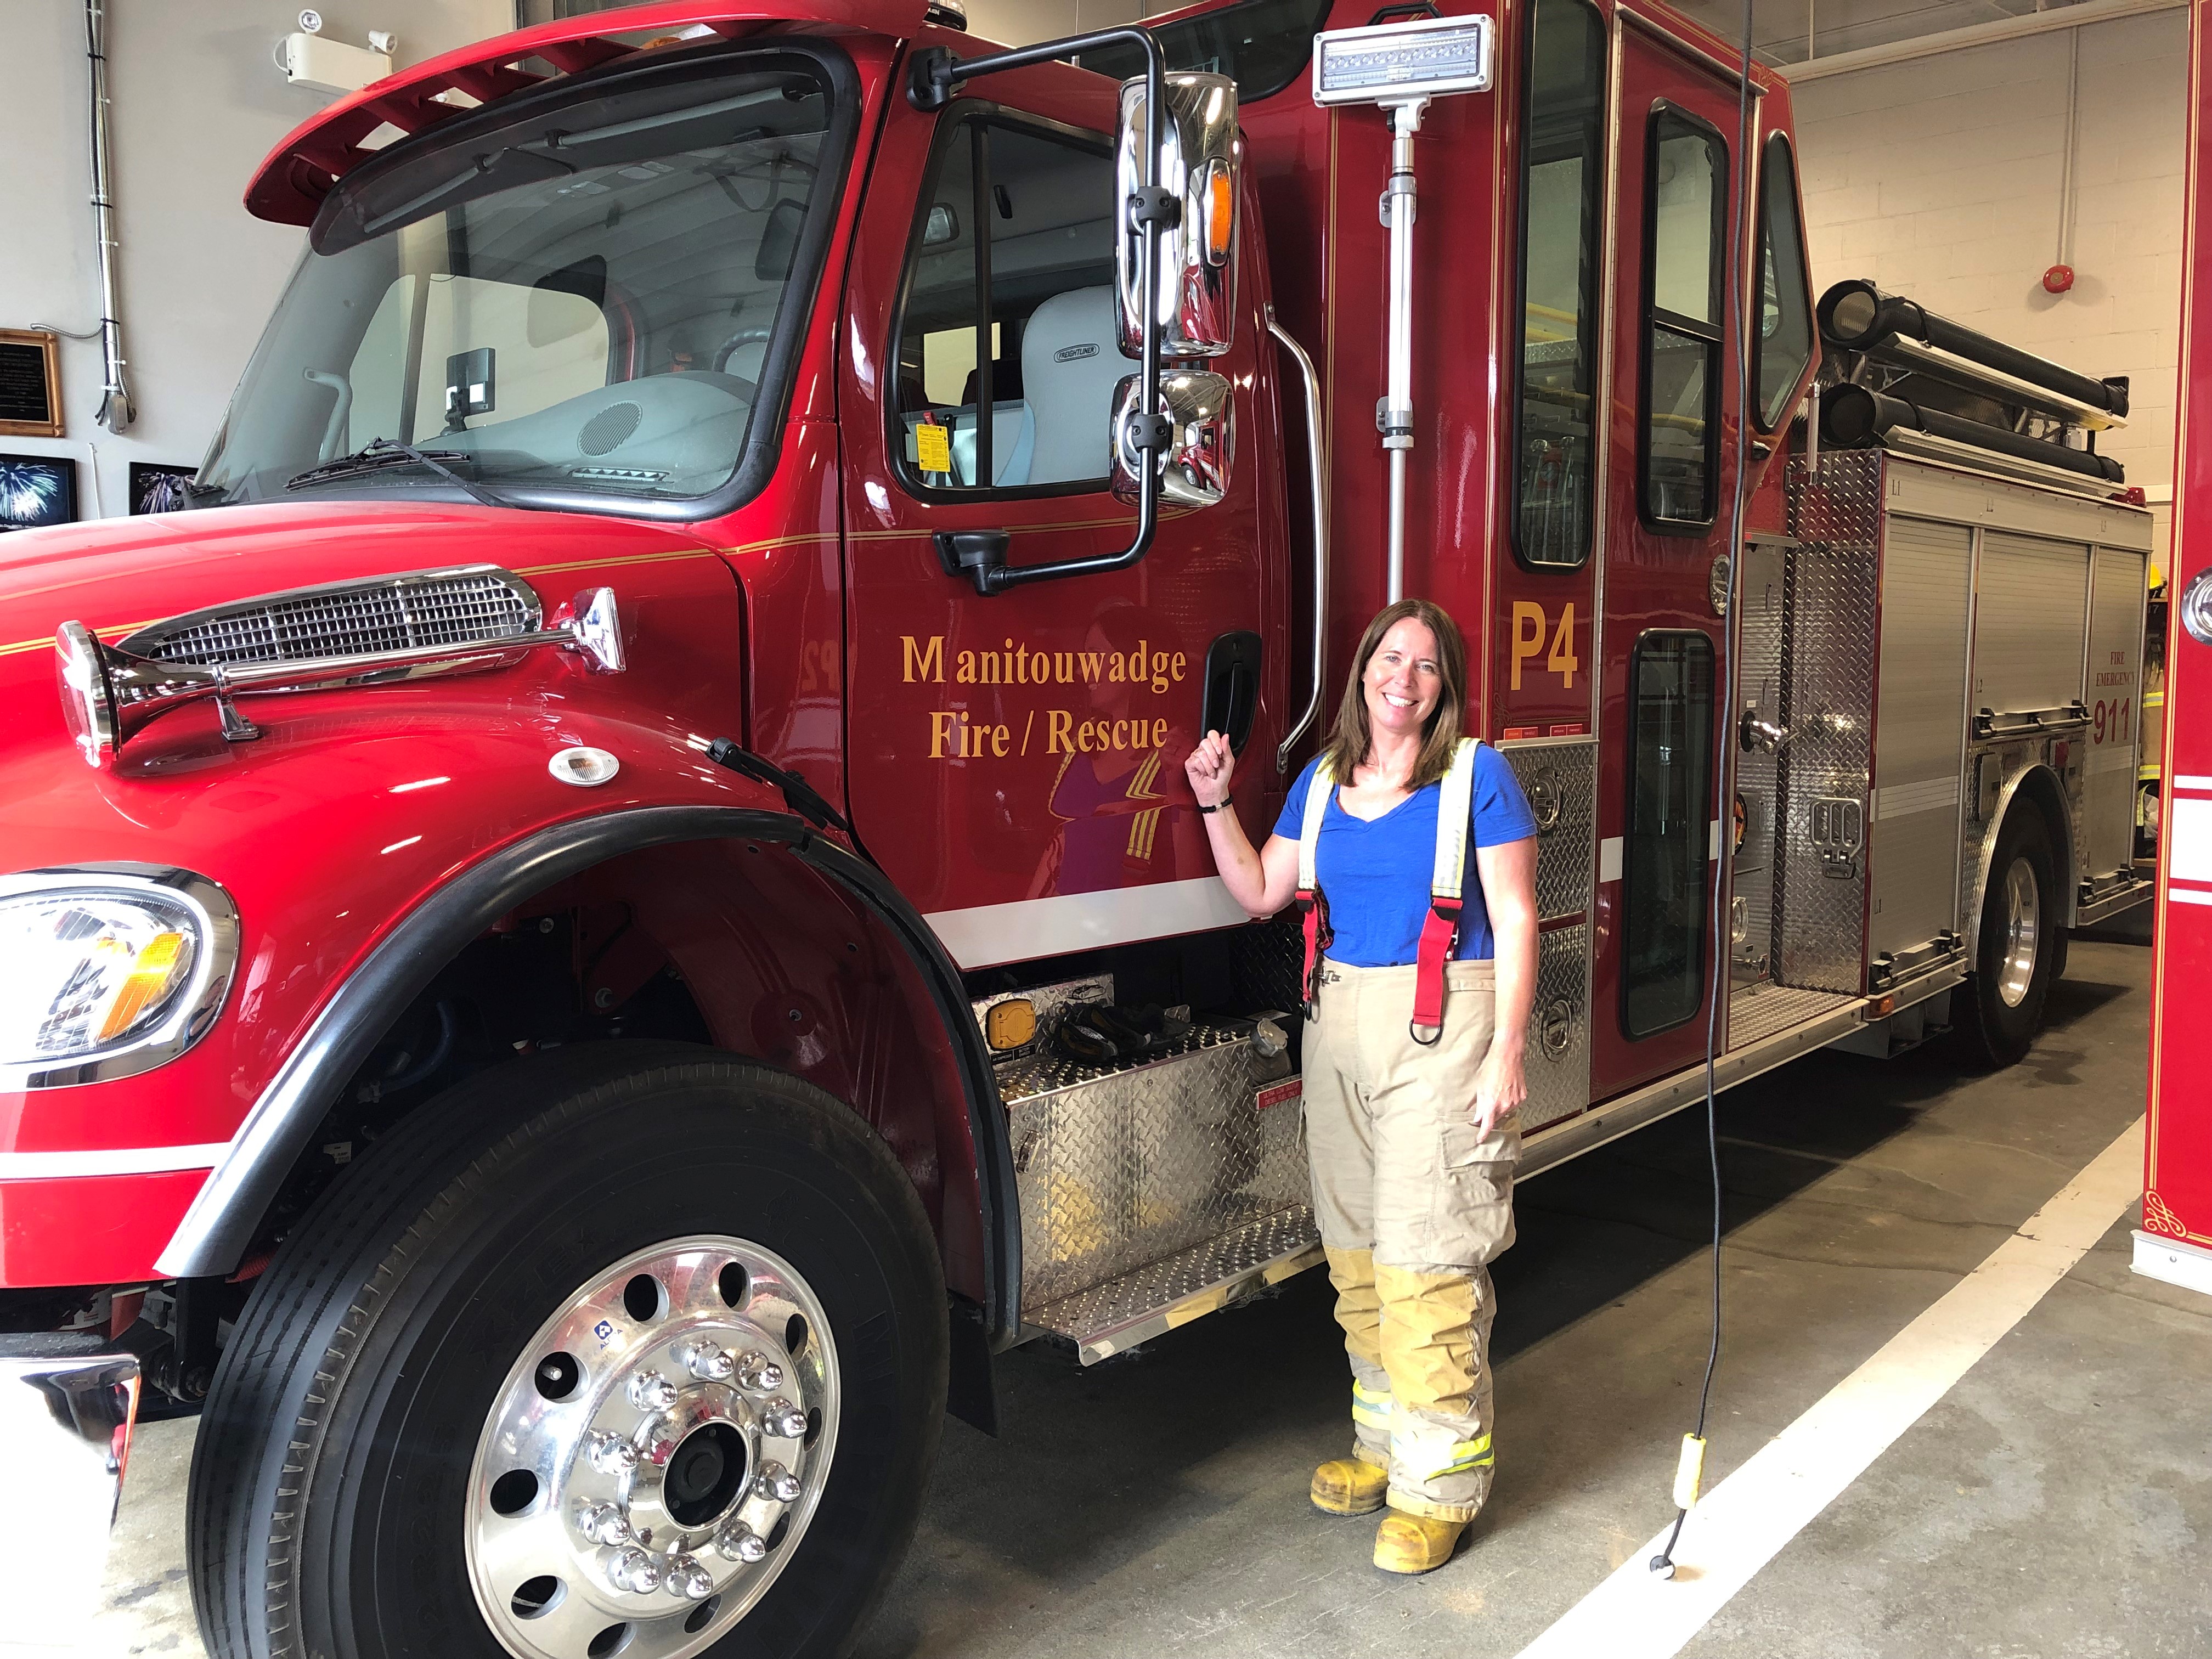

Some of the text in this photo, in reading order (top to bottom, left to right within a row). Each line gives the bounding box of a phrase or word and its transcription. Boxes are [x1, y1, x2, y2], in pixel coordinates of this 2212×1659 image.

[1058, 347, 1094, 359] FREIGHTLINER
[1510, 601, 1578, 691] P4
[2111, 651, 2125, 665] FIRE
[2094, 697, 2130, 744] 911
[928, 710, 1168, 758] Fire / Rescue
[1263, 1091, 1275, 1099] ULTRA
[1286, 1082, 1299, 1091] SULFUR
[1265, 1097, 1277, 1106] DIESEL
